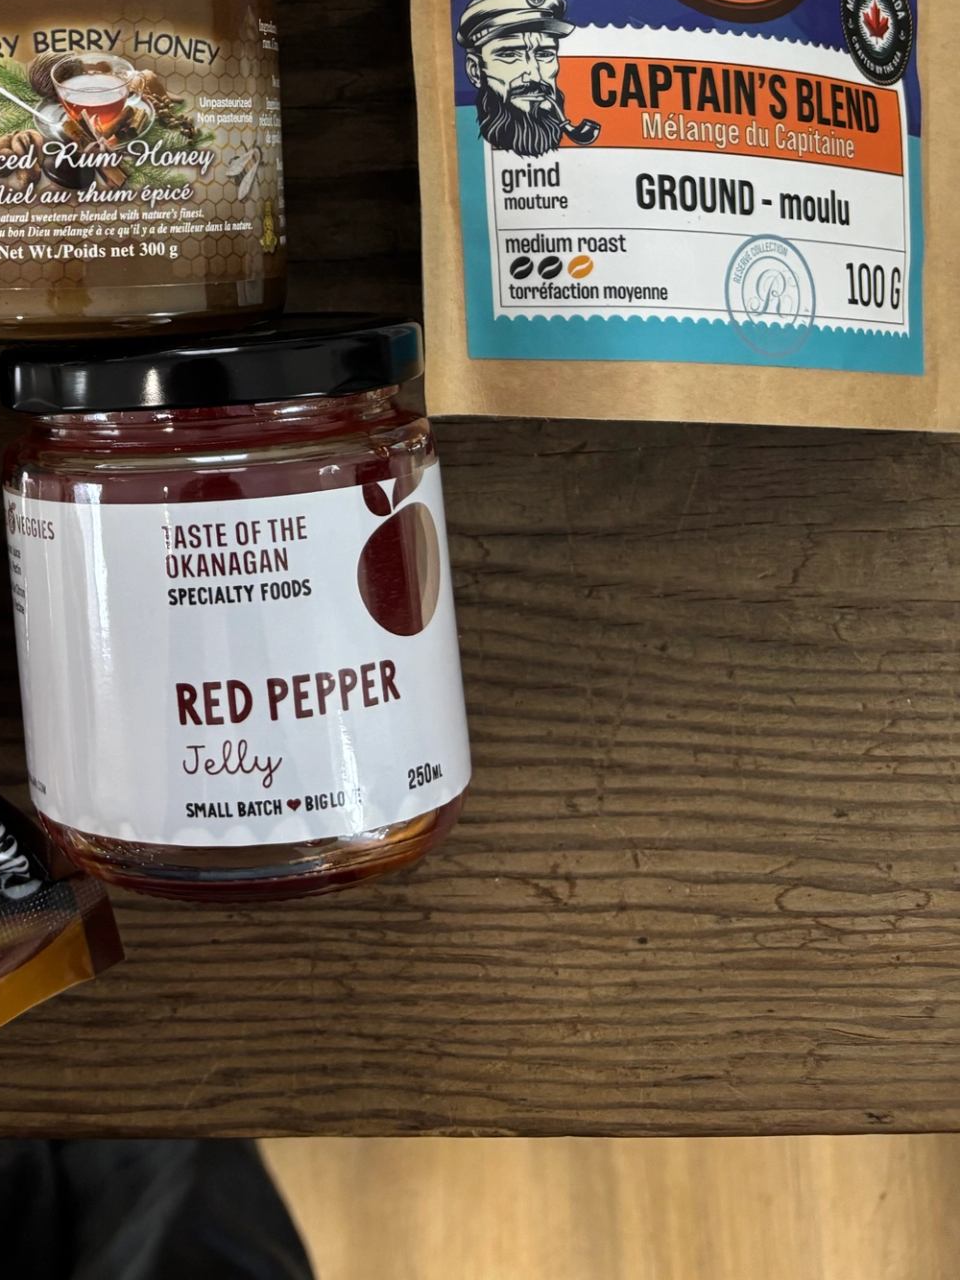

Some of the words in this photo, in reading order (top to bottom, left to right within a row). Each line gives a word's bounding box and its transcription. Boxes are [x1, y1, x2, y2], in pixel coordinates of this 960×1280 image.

[33, 28, 121, 54] BERRY
[134, 30, 221, 66] HONEY
[851, 35, 875, 71] CRAFTED
[199, 96, 253, 110] Unpasteurized
[590, 61, 788, 120] CAPTAIN'S
[797, 76, 880, 135] BLEND
[196, 111, 216, 123] Non
[641, 112, 741, 150] Mélange
[745, 121, 769, 149] du
[774, 123, 855, 160] Capitaine
[42, 141, 122, 170] Rum
[127, 139, 215, 175] Honey
[40, 190, 72, 204] au
[76, 183, 137, 204] rhum
[140, 183, 194, 208] épicé
[501, 161, 560, 193] grind
[635, 172, 754, 216] GROUND
[779, 188, 851, 227] moulu
[504, 193, 568, 211] mouture
[31, 213, 78, 223] sweetener
[79, 209, 117, 221] blended
[119, 208, 140, 220] with
[141, 207, 178, 220] nature's
[178, 207, 205, 221] finest.
[7, 226, 25, 238] bon
[27, 225, 51, 238] Dieu
[52, 224, 93, 239] mélangé
[95, 224, 102, 235] à
[104, 226, 115, 236] ce
[117, 223, 140, 239] qu'il
[156, 223, 168, 234] de
[169, 222, 204, 234] meilleur
[205, 221, 223, 233] dans
[505, 233, 573, 254] medium
[577, 234, 627, 254] roast
[28, 243, 107, 260] Wt./Poids
[110, 244, 135, 258] net
[139, 241, 166, 257] 300
[169, 245, 179, 259] g
[750, 241, 789, 257] COLLECTION
[509, 281, 600, 301] torréfaction
[603, 282, 668, 305] moyenne
[846, 261, 888, 308] 100
[889, 272, 901, 310] G
[16, 513, 55, 540] VEGGIES
[161, 523, 228, 550] TASTE
[235, 520, 261, 546] OF
[267, 515, 308, 543] THE
[166, 547, 289, 579] OKANAGAN
[168, 584, 254, 606] SPECIALTY
[260, 578, 312, 602] FOODS
[176, 679, 253, 726] RED
[267, 659, 402, 721] PEPPER
[182, 738, 284, 788] Jelly
[185, 802, 233, 819] SMALL
[237, 798, 283, 818] BATCH
[304, 793, 329, 813] BIG
